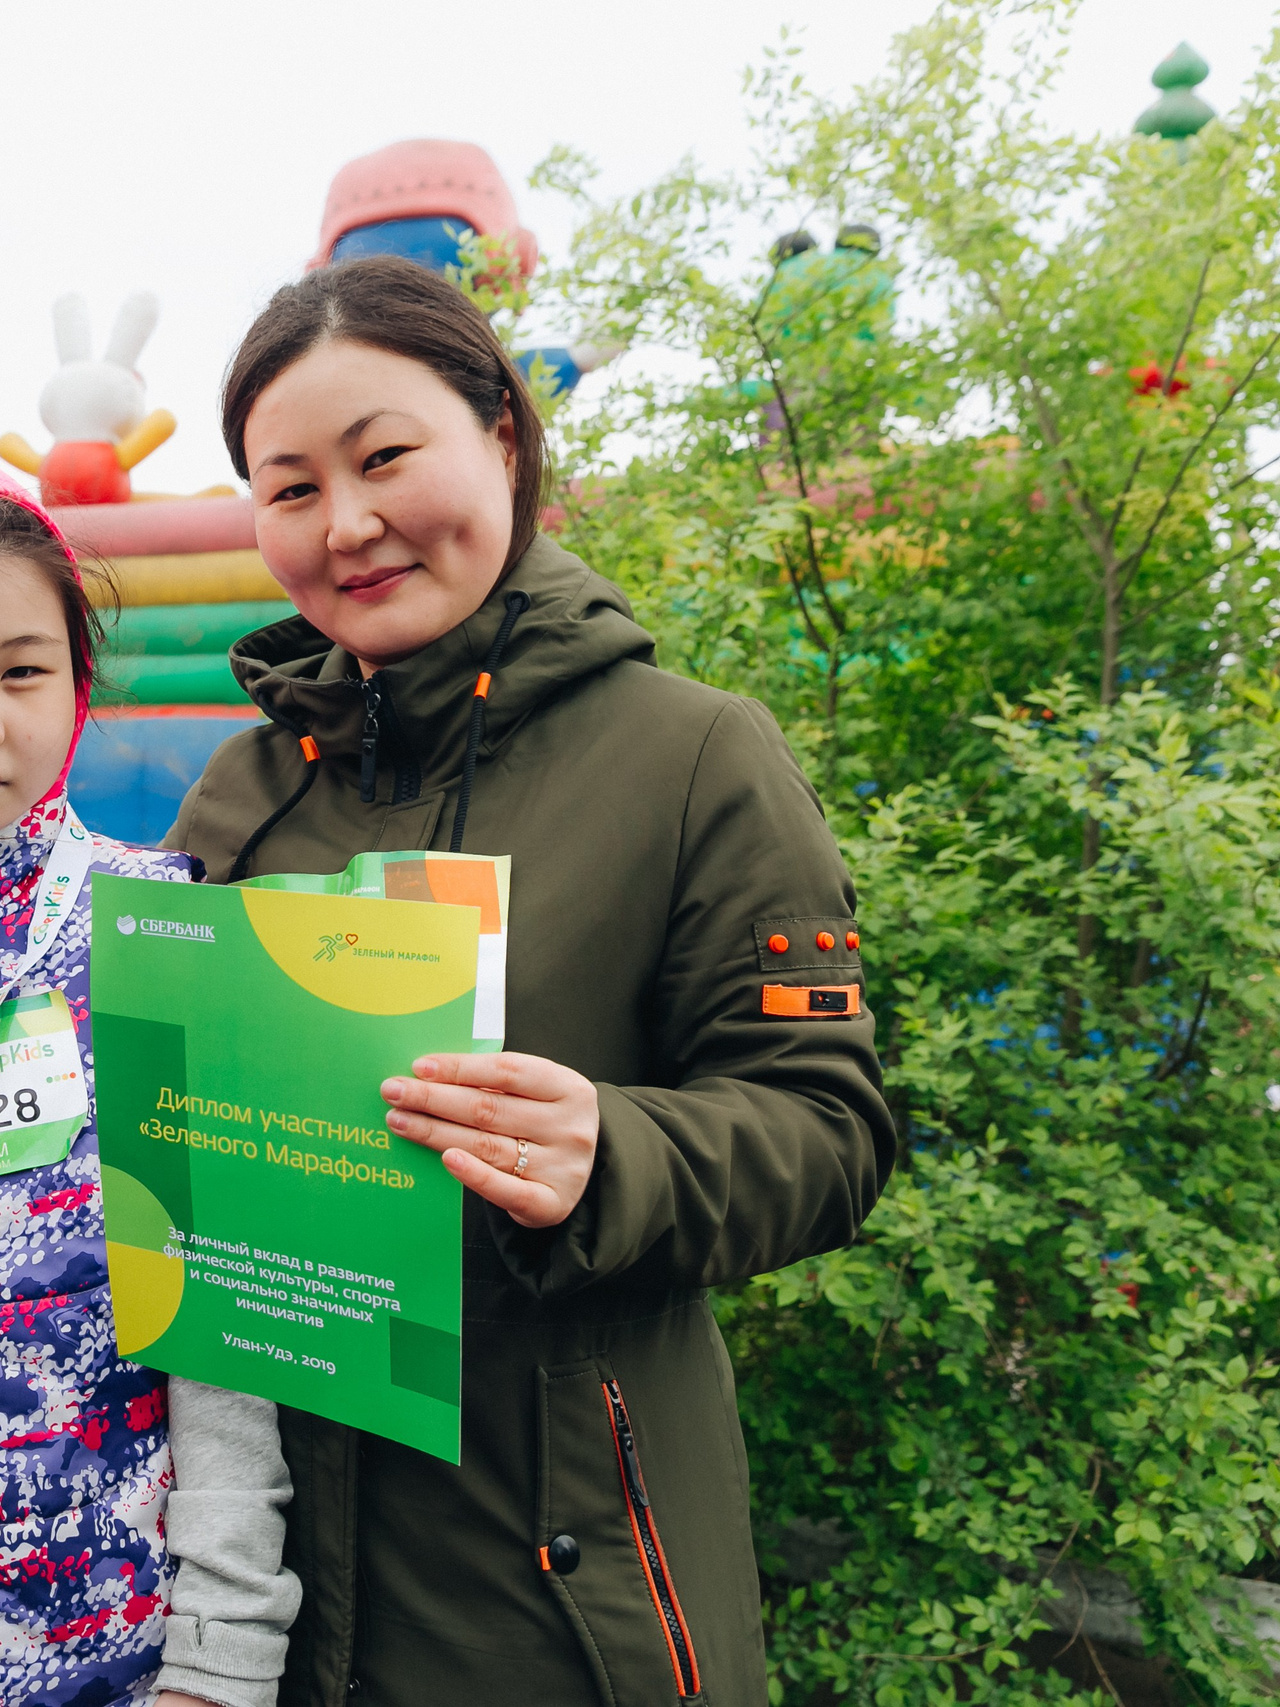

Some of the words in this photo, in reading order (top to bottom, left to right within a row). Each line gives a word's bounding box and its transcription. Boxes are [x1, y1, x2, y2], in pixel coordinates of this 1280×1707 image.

[140, 918, 216, 940] СБЕРБАНК
[352, 947, 395, 959] ЗЕЛЕНЫЙ
[397, 951, 441, 963] МАРАФОН
[156, 1086, 252, 1124] Диплом
[259, 1109, 391, 1150] участника
[139, 1118, 258, 1159] «Зеленого
[266, 1141, 416, 1190] Марафона»
[163, 1243, 256, 1276] физической
[259, 1268, 339, 1298] культуры,
[342, 1286, 401, 1312] спорта
[168, 1226, 185, 1242] За
[189, 1232, 250, 1257] личный
[253, 1248, 301, 1271] вклад
[305, 1259, 314, 1272] в
[318, 1262, 396, 1292] развитие
[190, 1269, 200, 1280] и
[204, 1272, 288, 1301] социально
[291, 1293, 374, 1323] значимых
[236, 1297, 325, 1328] инициатив
[221, 1331, 298, 1365] Улан-Удэ,
[301, 1354, 337, 1375] 2019
